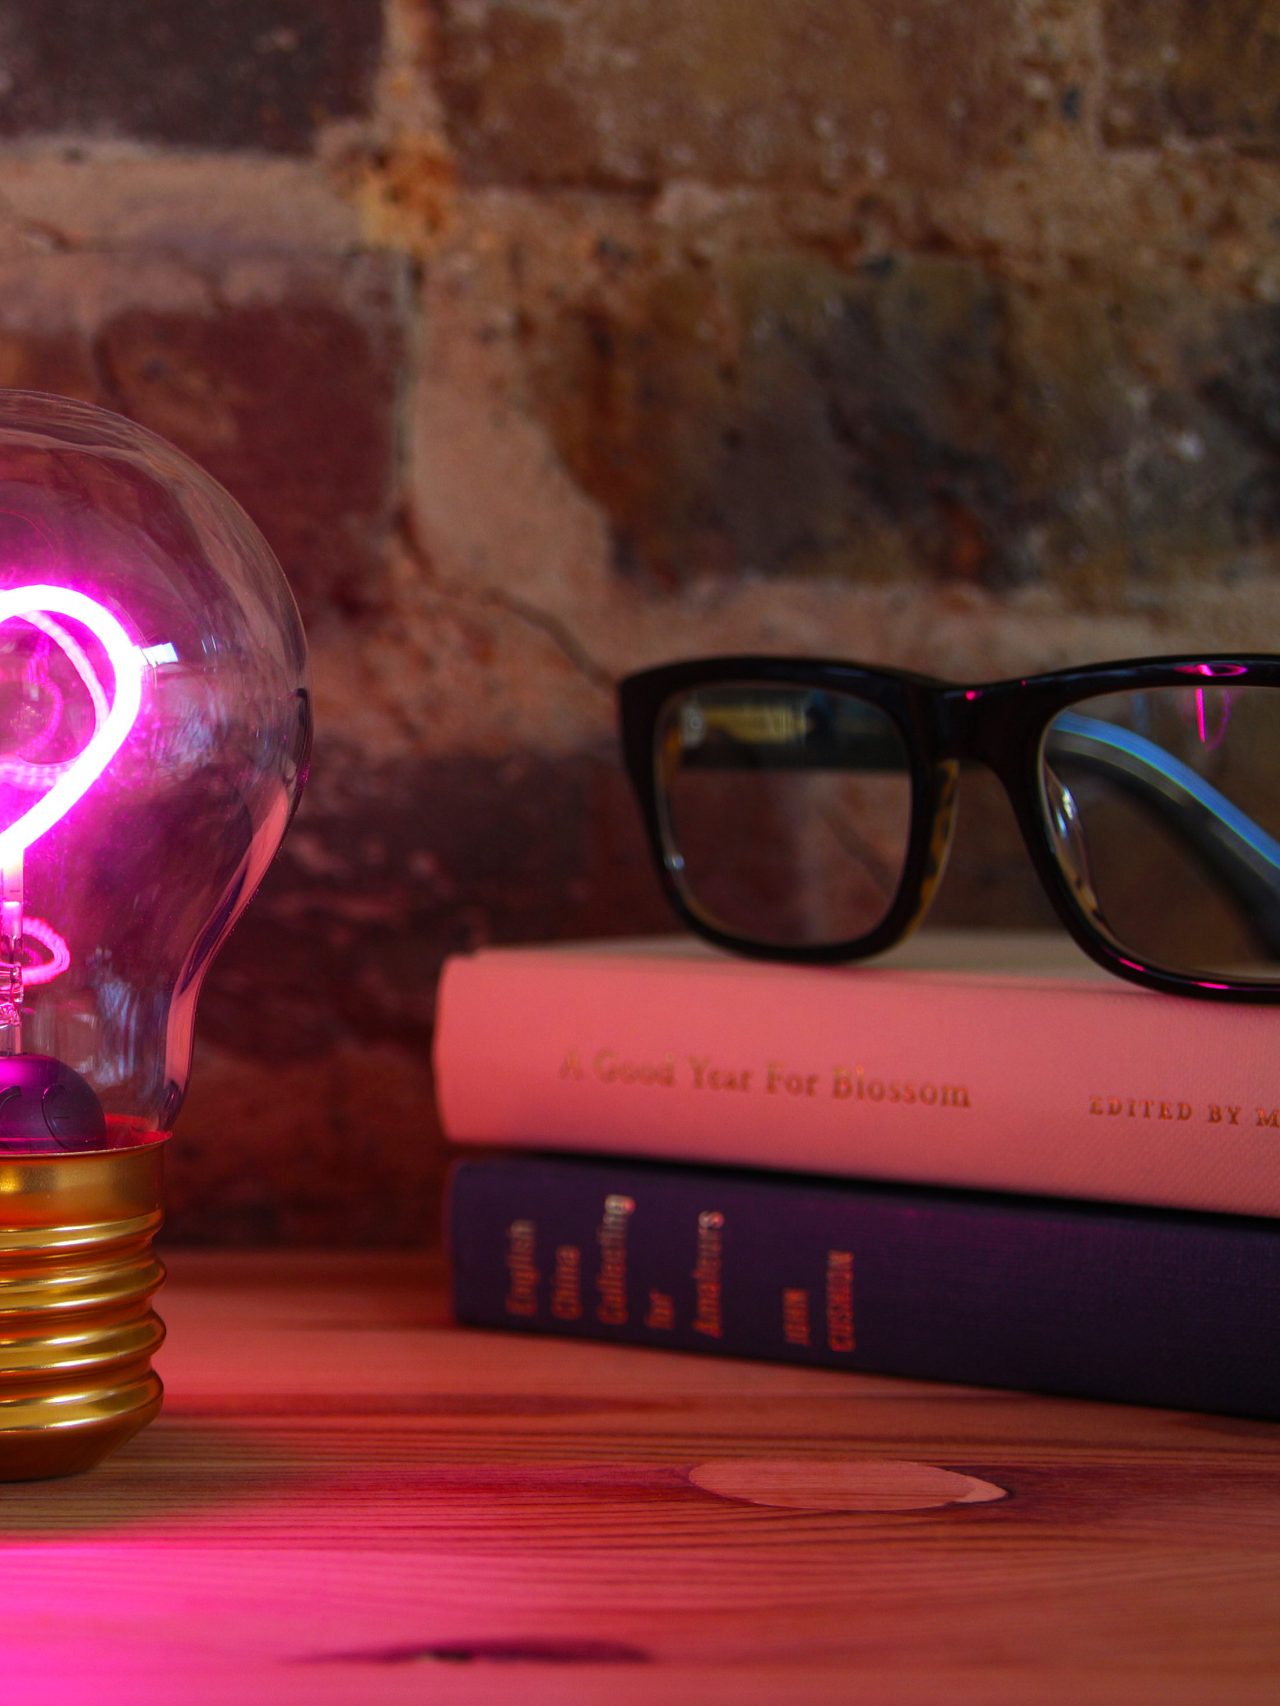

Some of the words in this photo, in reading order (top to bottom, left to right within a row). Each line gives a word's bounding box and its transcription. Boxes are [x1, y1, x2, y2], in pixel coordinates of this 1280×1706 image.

[558, 1049, 585, 1082] A
[593, 1048, 676, 1088] Good
[686, 1055, 753, 1093] Year
[767, 1060, 819, 1098] For
[832, 1064, 972, 1108] Blossom
[1089, 1096, 1193, 1121] EDITED
[1207, 1104, 1243, 1126] BY
[505, 1218, 539, 1317] English
[551, 1245, 583, 1320] China
[596, 1194, 636, 1326] Collecting
